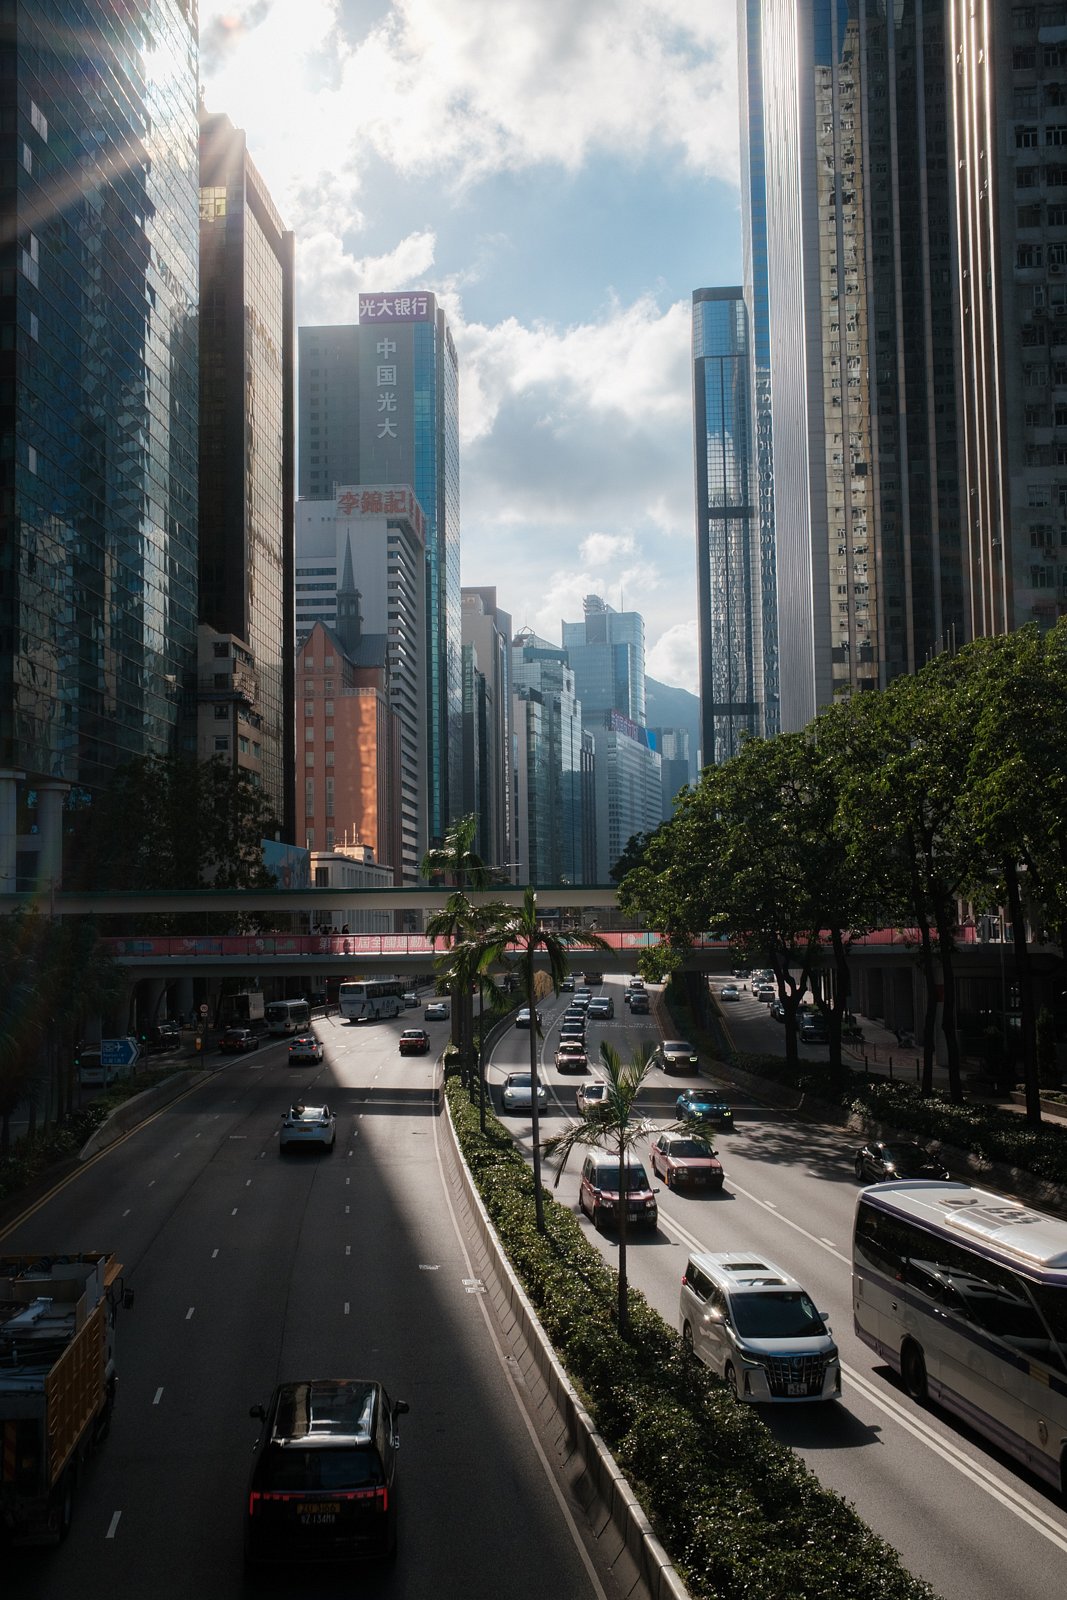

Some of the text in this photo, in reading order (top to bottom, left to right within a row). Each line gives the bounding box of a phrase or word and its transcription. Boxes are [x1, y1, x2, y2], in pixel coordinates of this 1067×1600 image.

[360, 297, 427, 317] 光大银行
[376, 337, 397, 439] 中国光大
[337, 490, 406, 515] 李錦記
